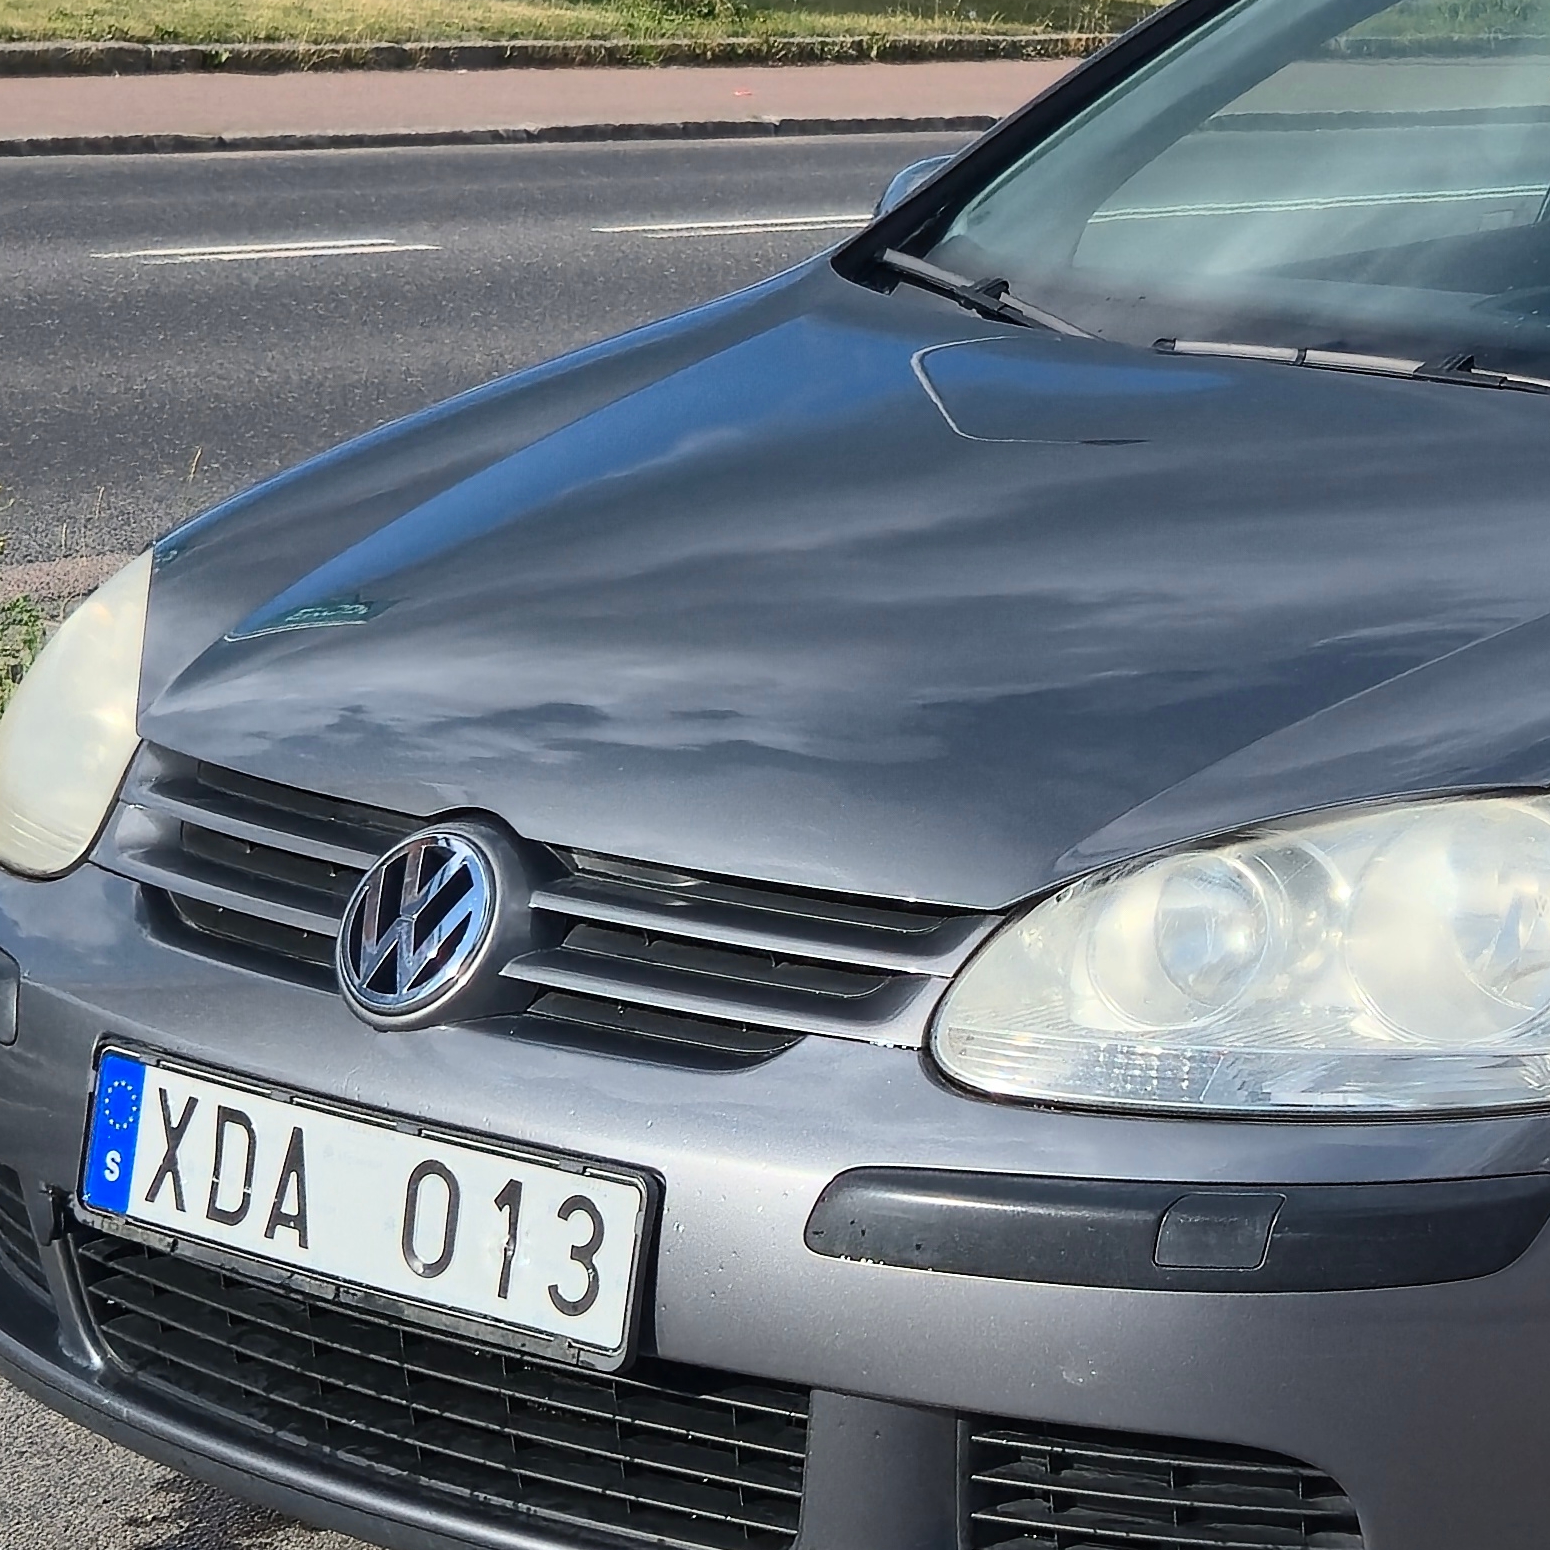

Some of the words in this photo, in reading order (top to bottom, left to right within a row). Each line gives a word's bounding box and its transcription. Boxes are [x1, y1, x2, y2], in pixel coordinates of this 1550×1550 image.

[103, 1149, 122, 1183] S
[144, 1087, 310, 1250] XDA
[400, 1158, 607, 1318] 013
